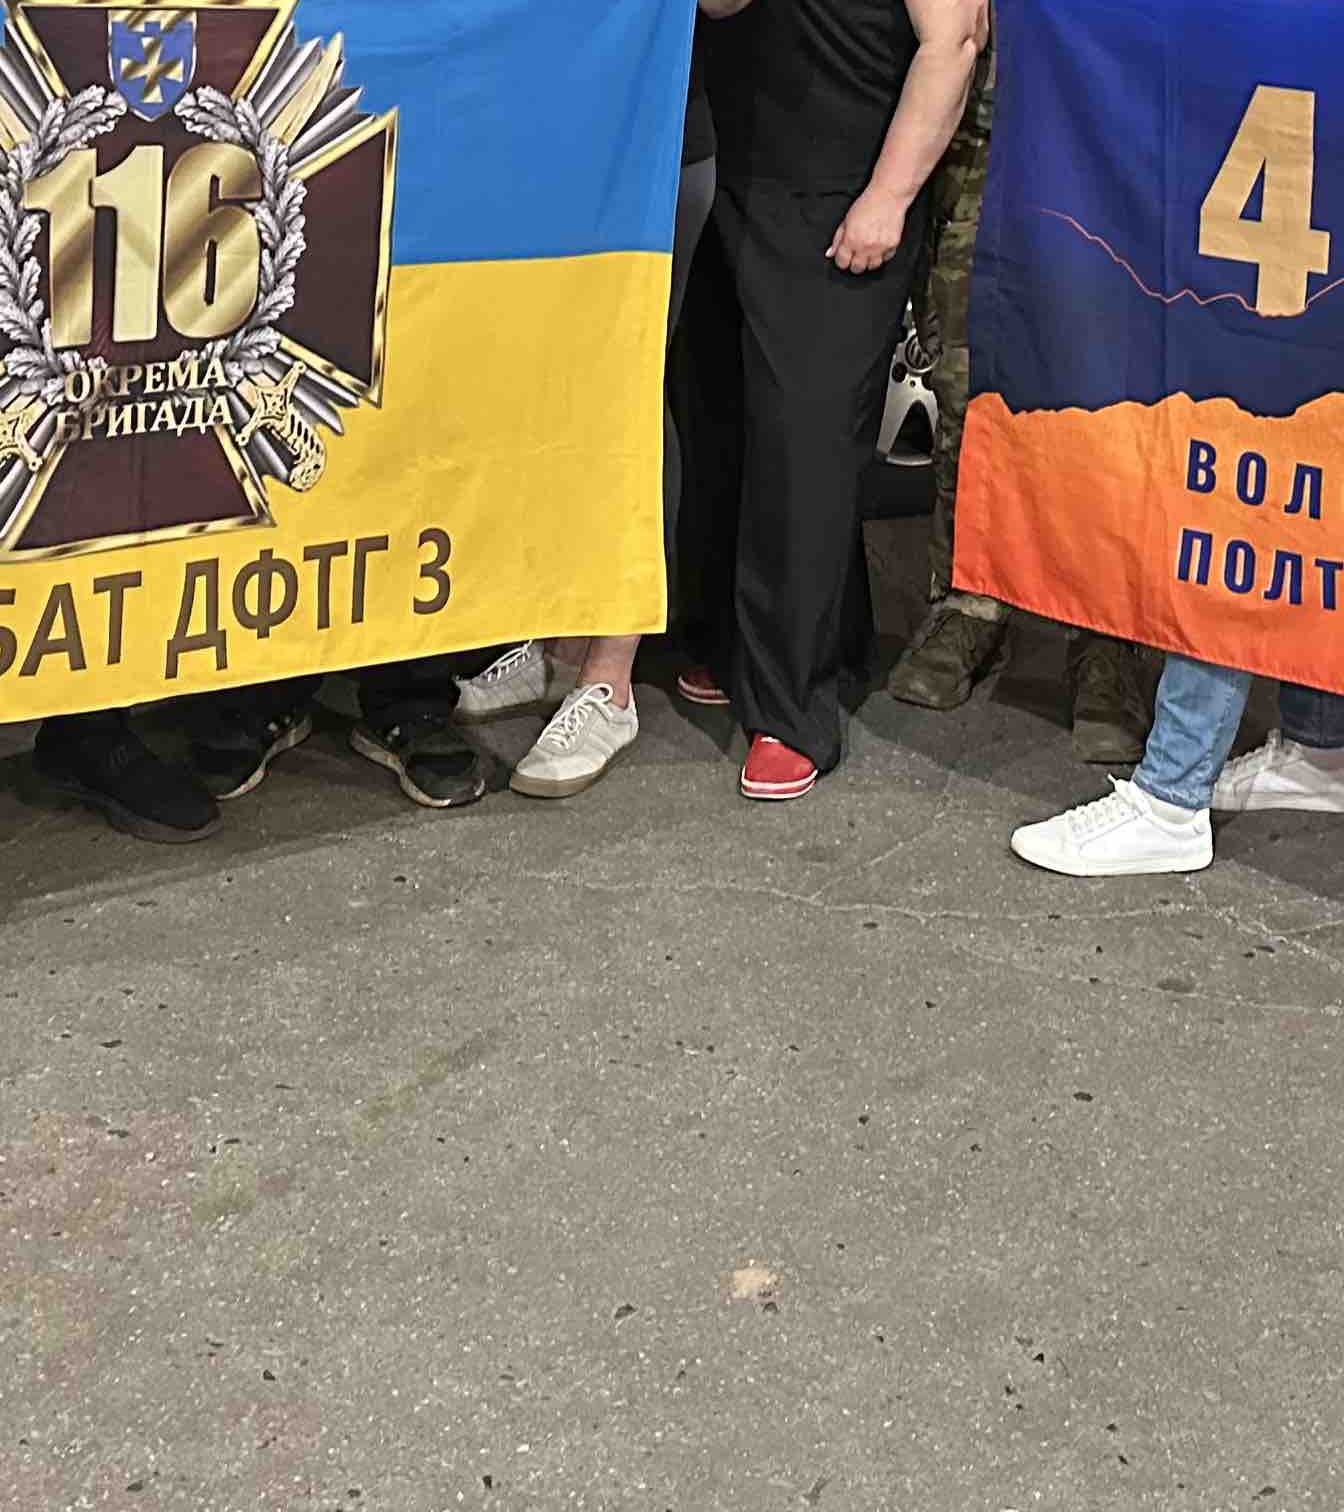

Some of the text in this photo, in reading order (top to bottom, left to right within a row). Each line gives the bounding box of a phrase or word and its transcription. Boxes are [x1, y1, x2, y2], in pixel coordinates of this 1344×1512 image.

[24, 143, 265, 349] 116
[55, 394, 233, 440] БРИГАДА
[64, 357, 228, 404] ОКРЕМА
[164, 535, 389, 680] ДФТГ
[413, 528, 452, 615] 3
